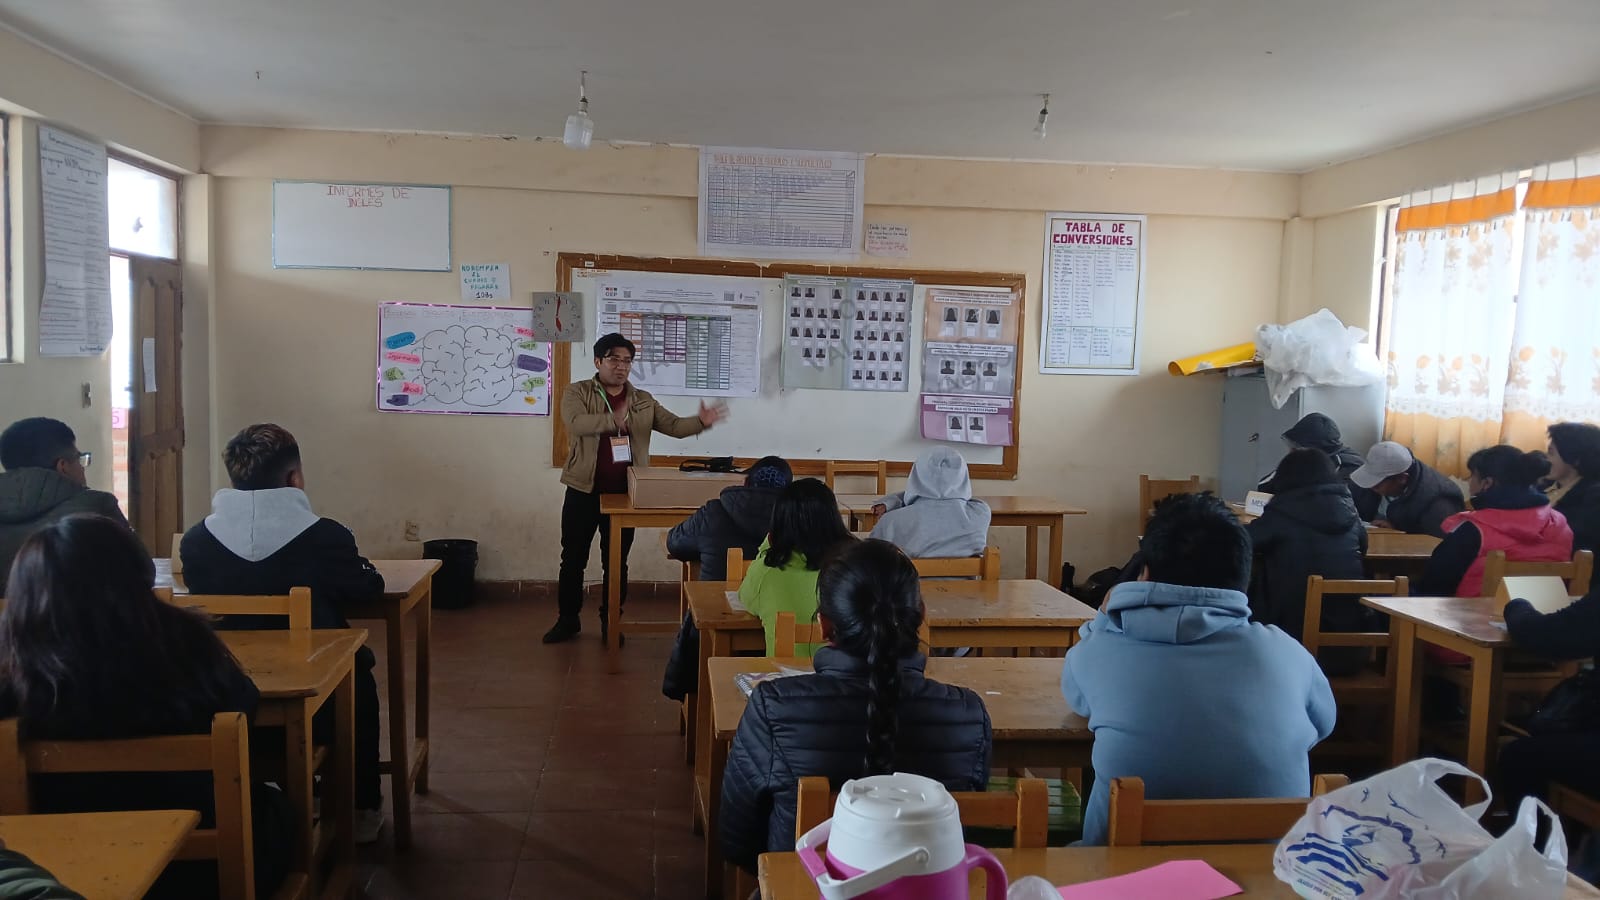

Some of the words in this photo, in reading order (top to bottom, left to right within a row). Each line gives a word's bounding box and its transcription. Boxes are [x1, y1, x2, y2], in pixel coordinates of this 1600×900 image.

[392, 187, 410, 199] DE
[1065, 222, 1102, 233] TABLA
[1112, 223, 1125, 233] DE
[1053, 234, 1134, 246] CONVERSIONES
